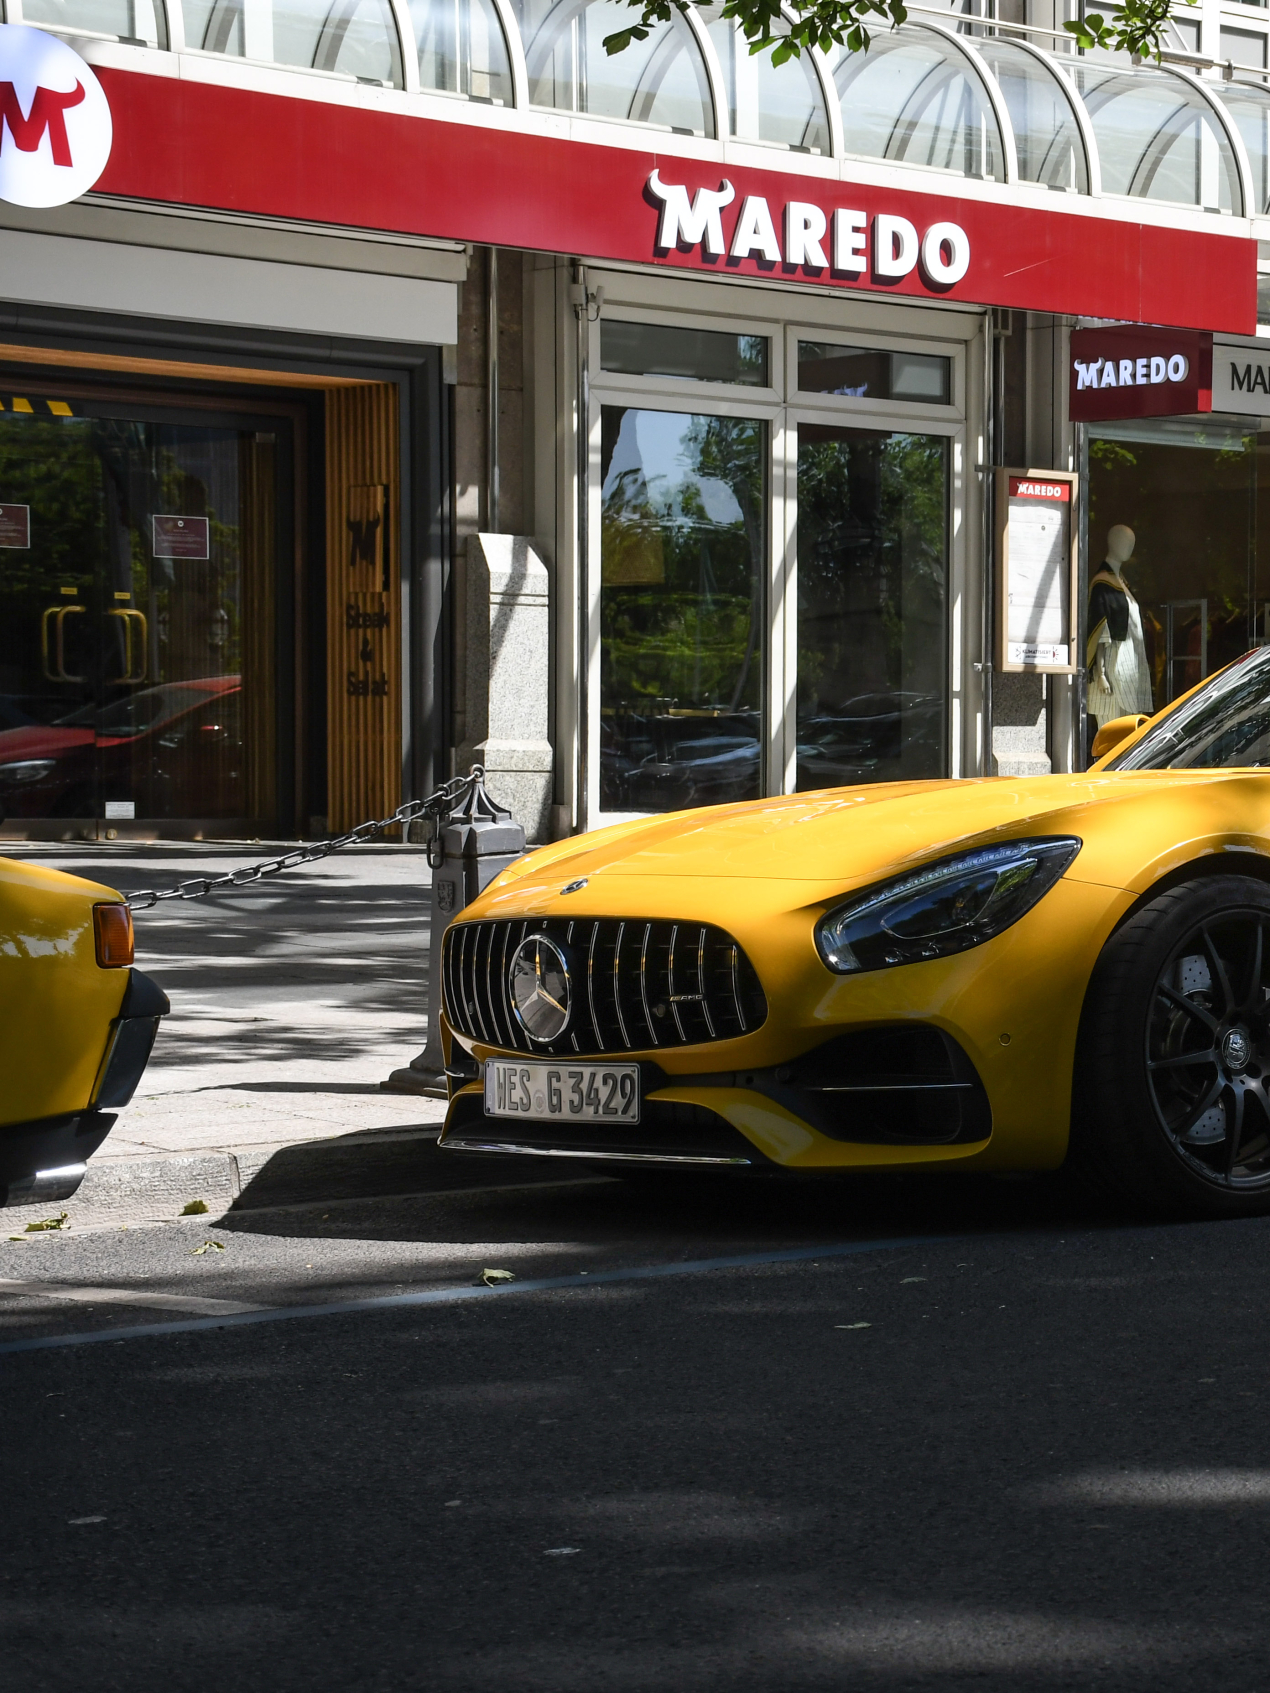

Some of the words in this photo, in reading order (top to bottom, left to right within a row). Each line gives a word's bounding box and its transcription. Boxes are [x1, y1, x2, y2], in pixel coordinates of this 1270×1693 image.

[648, 168, 970, 284] MAREDO
[1074, 354, 1189, 390] MAREDO
[1017, 482, 1062, 497] MAREDO
[346, 603, 390, 629] Steak
[360, 637, 374, 662] &
[346, 671, 388, 696] Salat
[496, 1067, 531, 1112] WES
[547, 1071, 562, 1113] G
[568, 1071, 636, 1115] 3429
